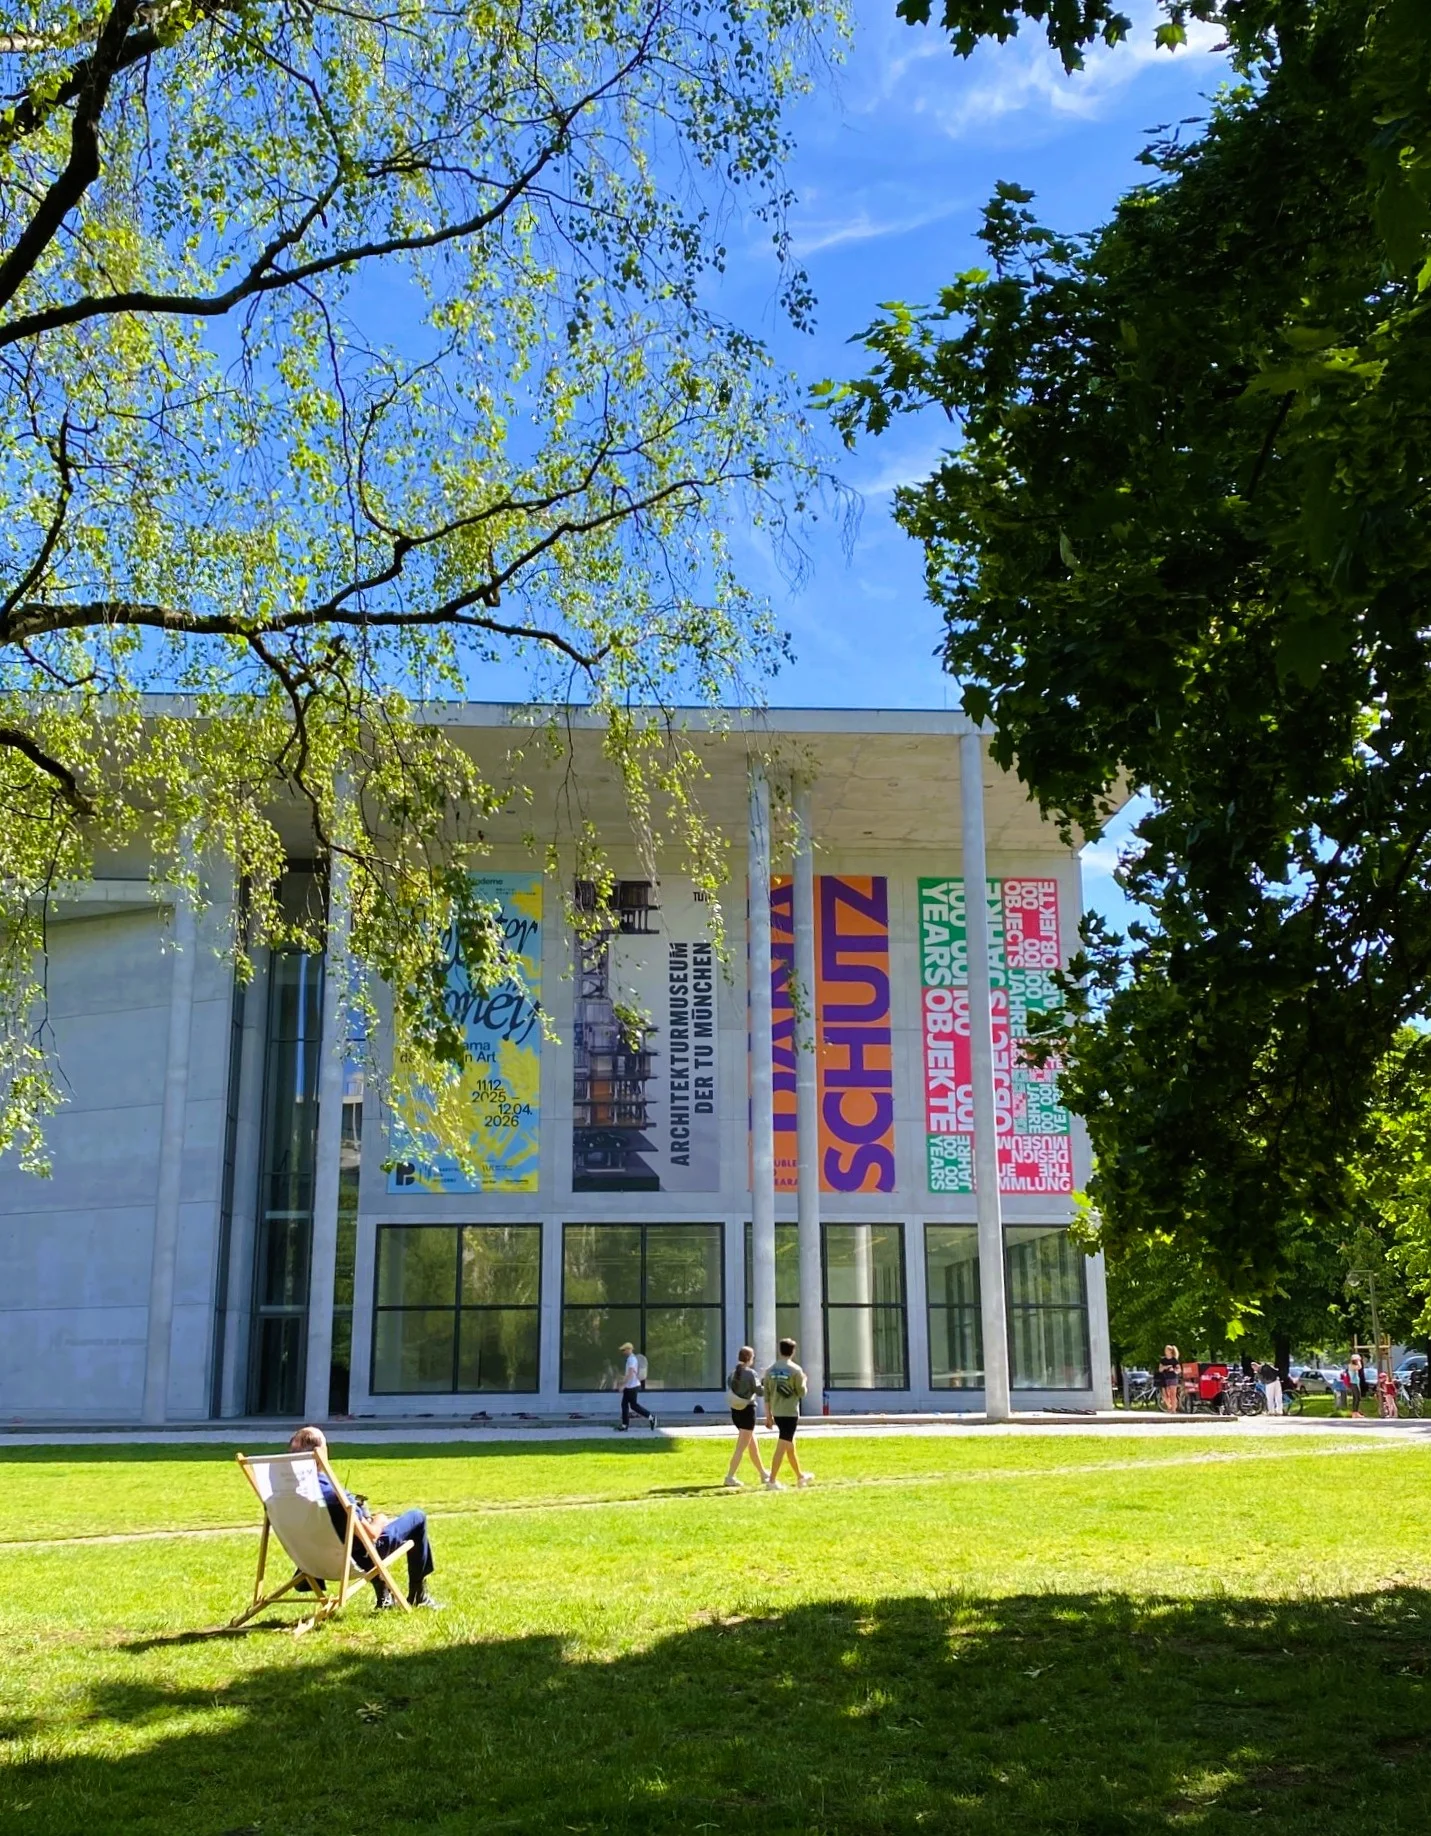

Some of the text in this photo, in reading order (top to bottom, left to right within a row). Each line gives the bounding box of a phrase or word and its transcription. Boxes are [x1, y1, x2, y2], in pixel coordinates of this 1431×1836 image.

[1004, 880, 1026, 968] OBJECTS
[1021, 881, 1039, 911] 100
[922, 882, 951, 986] YEARS
[1038, 881, 1060, 969] OBJEKTE
[691, 942, 715, 1114] DER TU MÜNCHEN
[1008, 970, 1027, 1037] JAHRE
[476, 1052, 497, 1063] Art
[669, 942, 690, 1166] ARCHITEKTURMUSEUM
[822, 876, 895, 1192] SCHUTZ
[926, 990, 957, 1131] OBJEKTE
[472, 1091, 507, 1103] 2025
[484, 1115, 519, 1127] 2026
[929, 1135, 946, 1191] YEARS
[957, 1135, 973, 1191] JAHRE
[997, 1135, 1069, 1150] MUSEUM
[1011, 1150, 1070, 1164] DESIGN
[1038, 1163, 1071, 1177] THE
